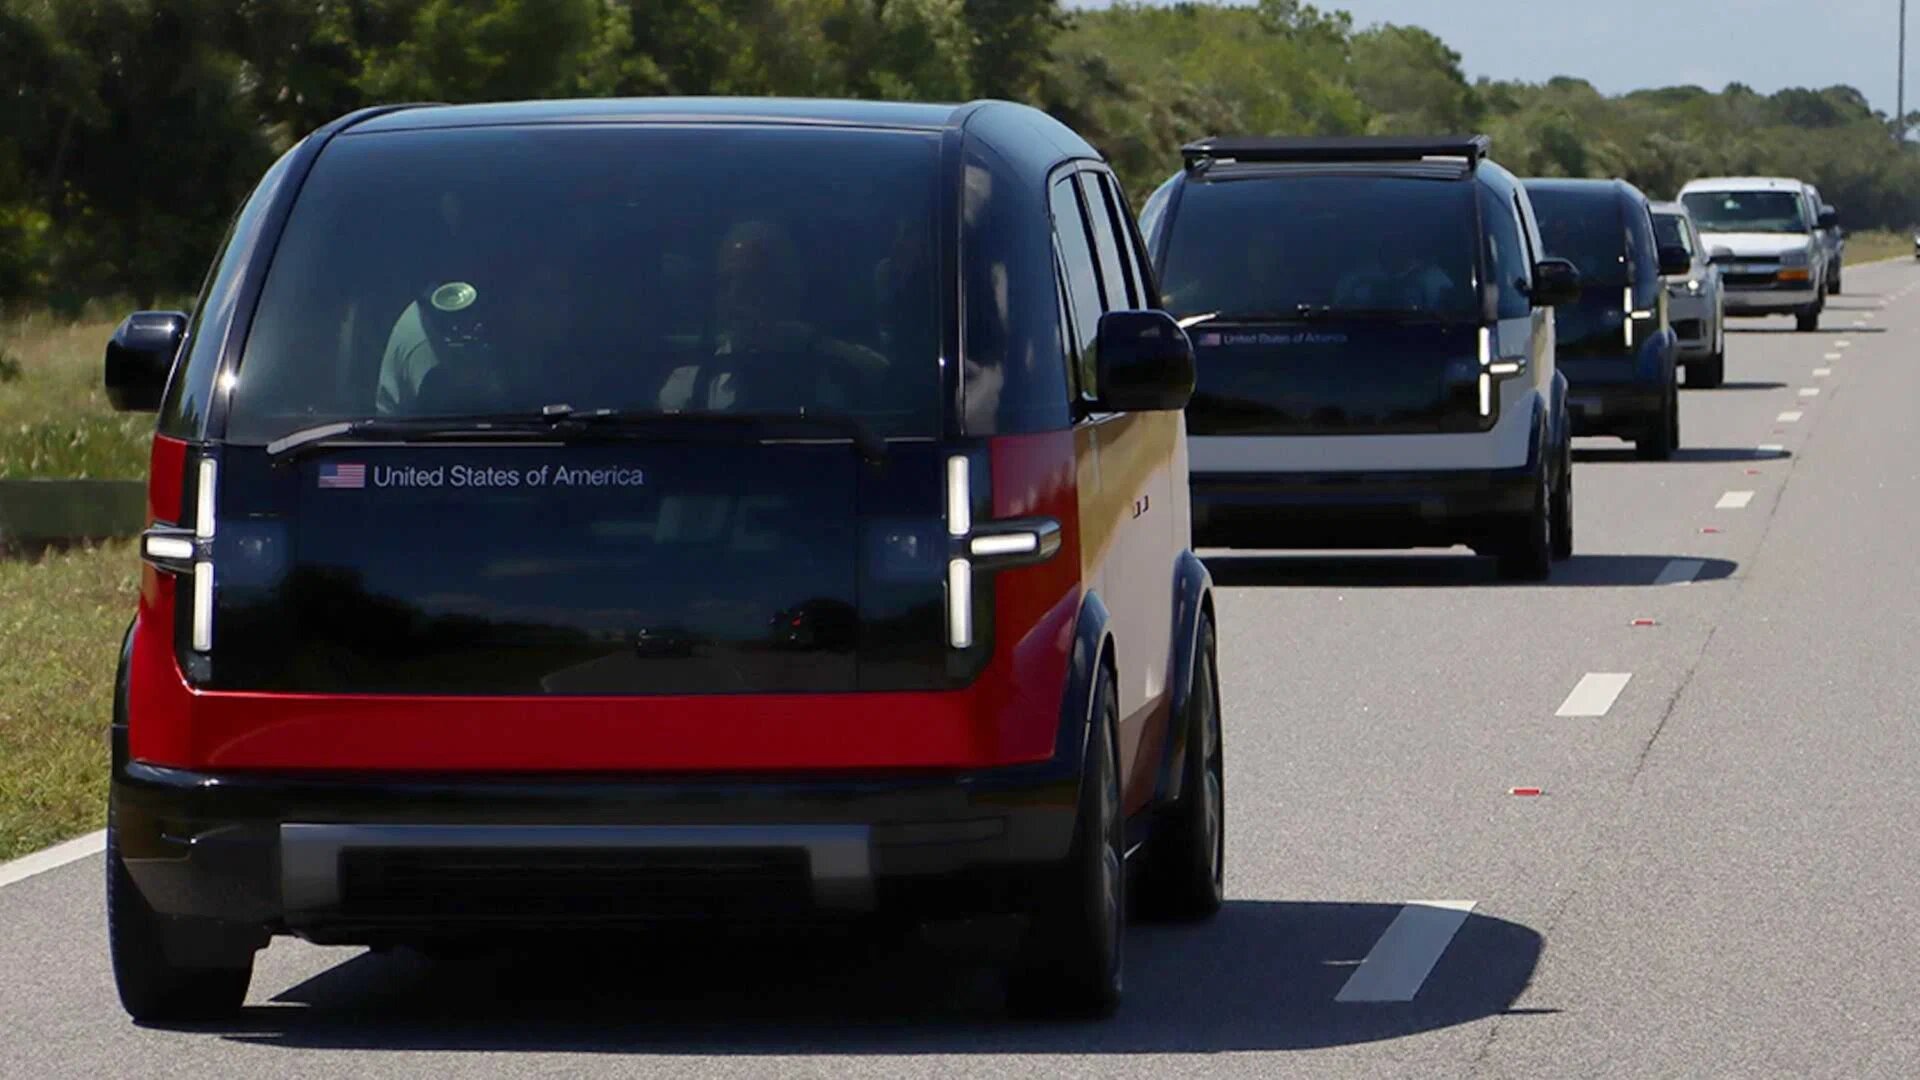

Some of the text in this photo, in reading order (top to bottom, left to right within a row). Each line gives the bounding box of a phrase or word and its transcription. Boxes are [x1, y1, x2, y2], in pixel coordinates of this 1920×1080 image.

[373, 465, 644, 487] United States of America
